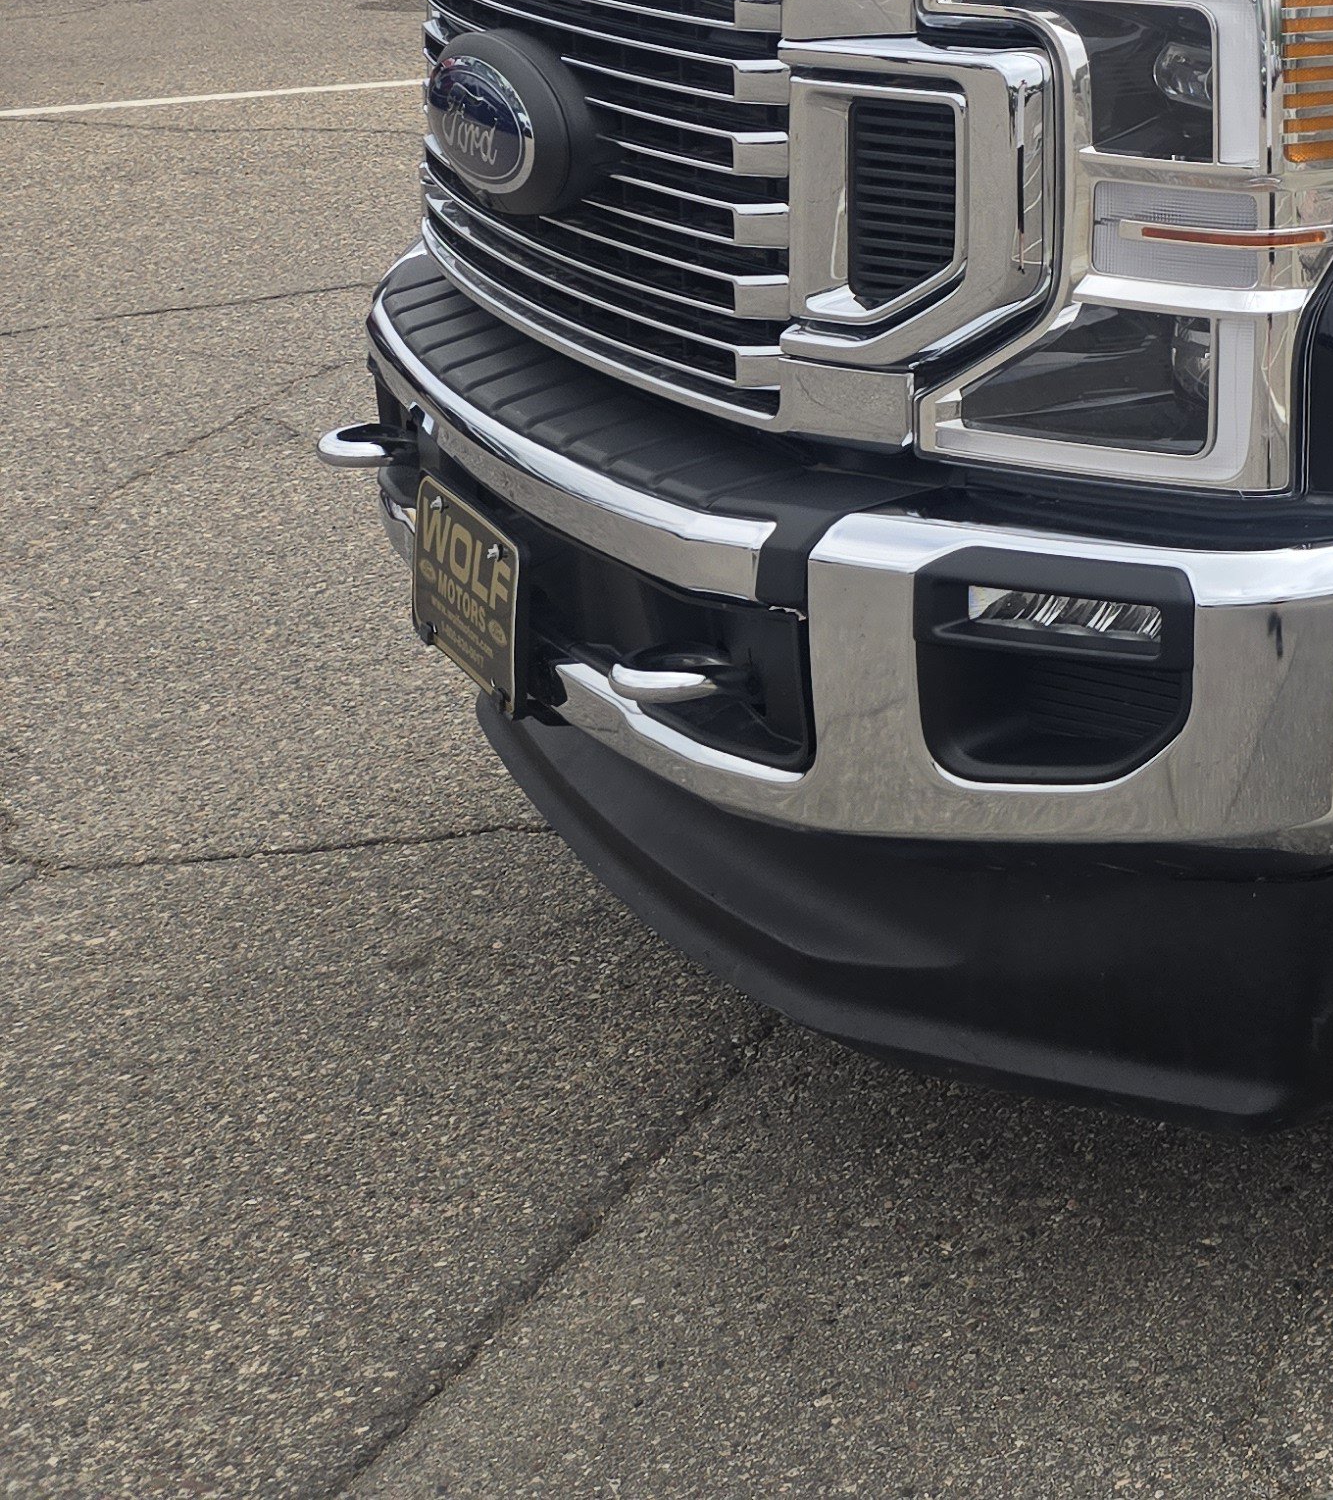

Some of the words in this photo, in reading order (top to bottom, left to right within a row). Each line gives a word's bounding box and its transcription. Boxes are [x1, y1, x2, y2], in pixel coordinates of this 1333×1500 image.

[442, 82, 499, 166] Ford
[422, 495, 512, 611] WOLF
[437, 568, 486, 633] MOTORS
